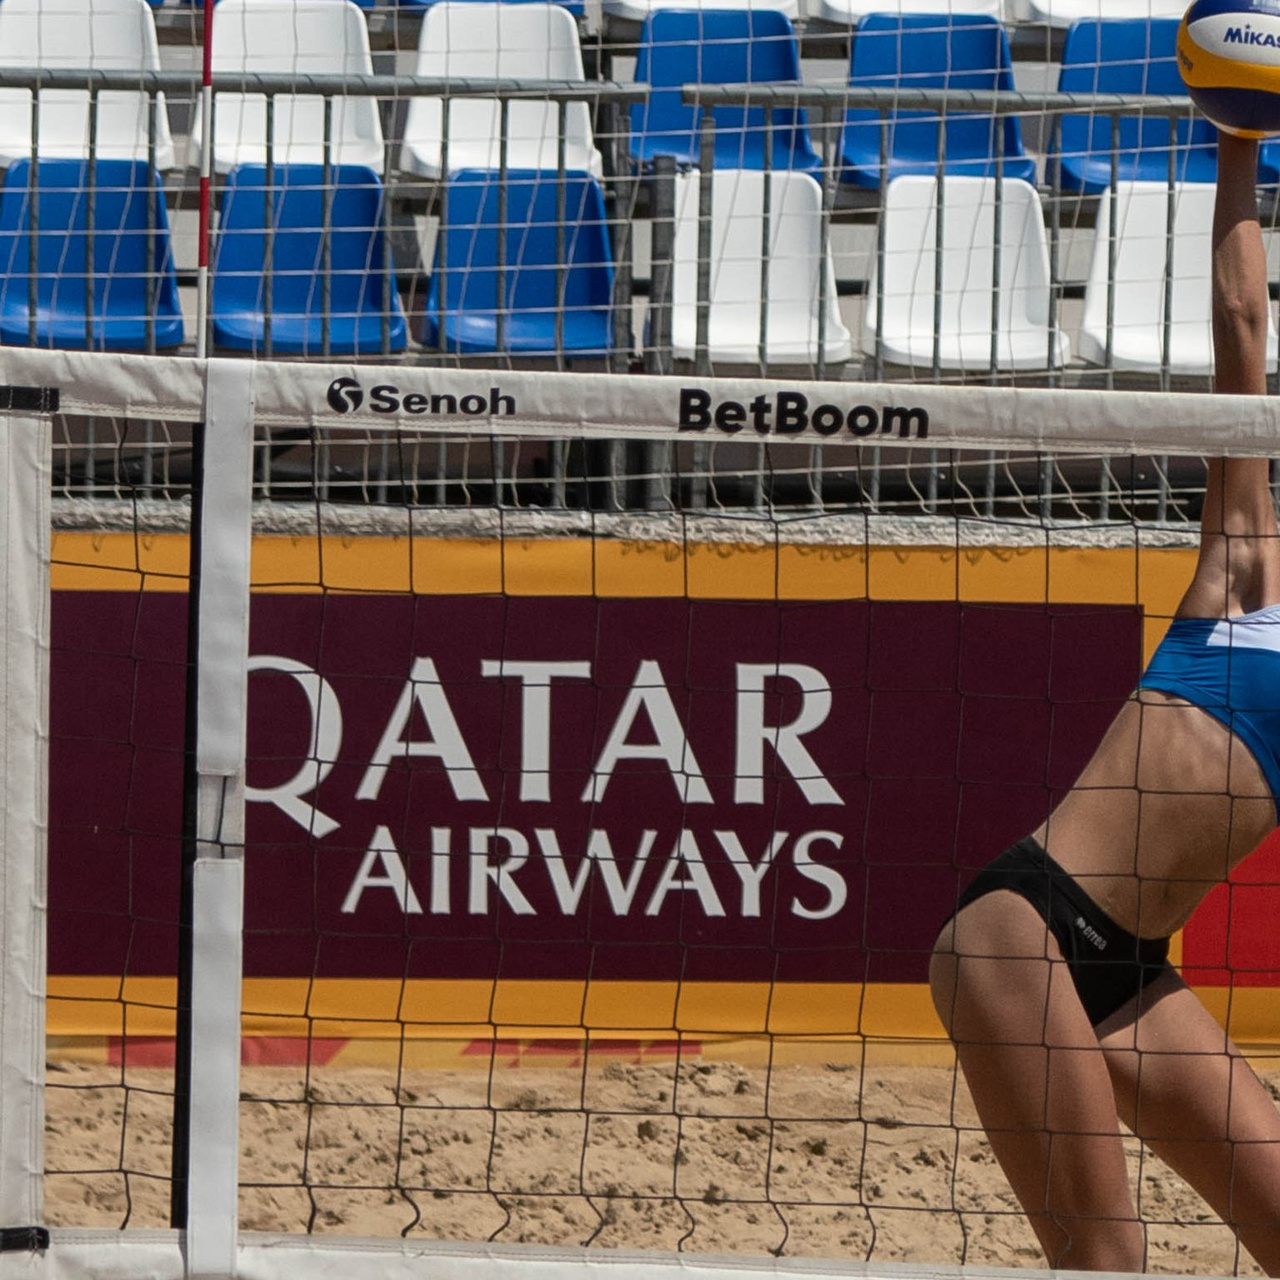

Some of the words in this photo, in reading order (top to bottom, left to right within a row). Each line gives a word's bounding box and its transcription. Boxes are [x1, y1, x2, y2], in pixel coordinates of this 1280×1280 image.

[369, 385, 516, 415] Senoh
[679, 388, 929, 438] BetBoom
[246, 655, 845, 838] QATAR
[341, 825, 848, 919] AIRWAYS
